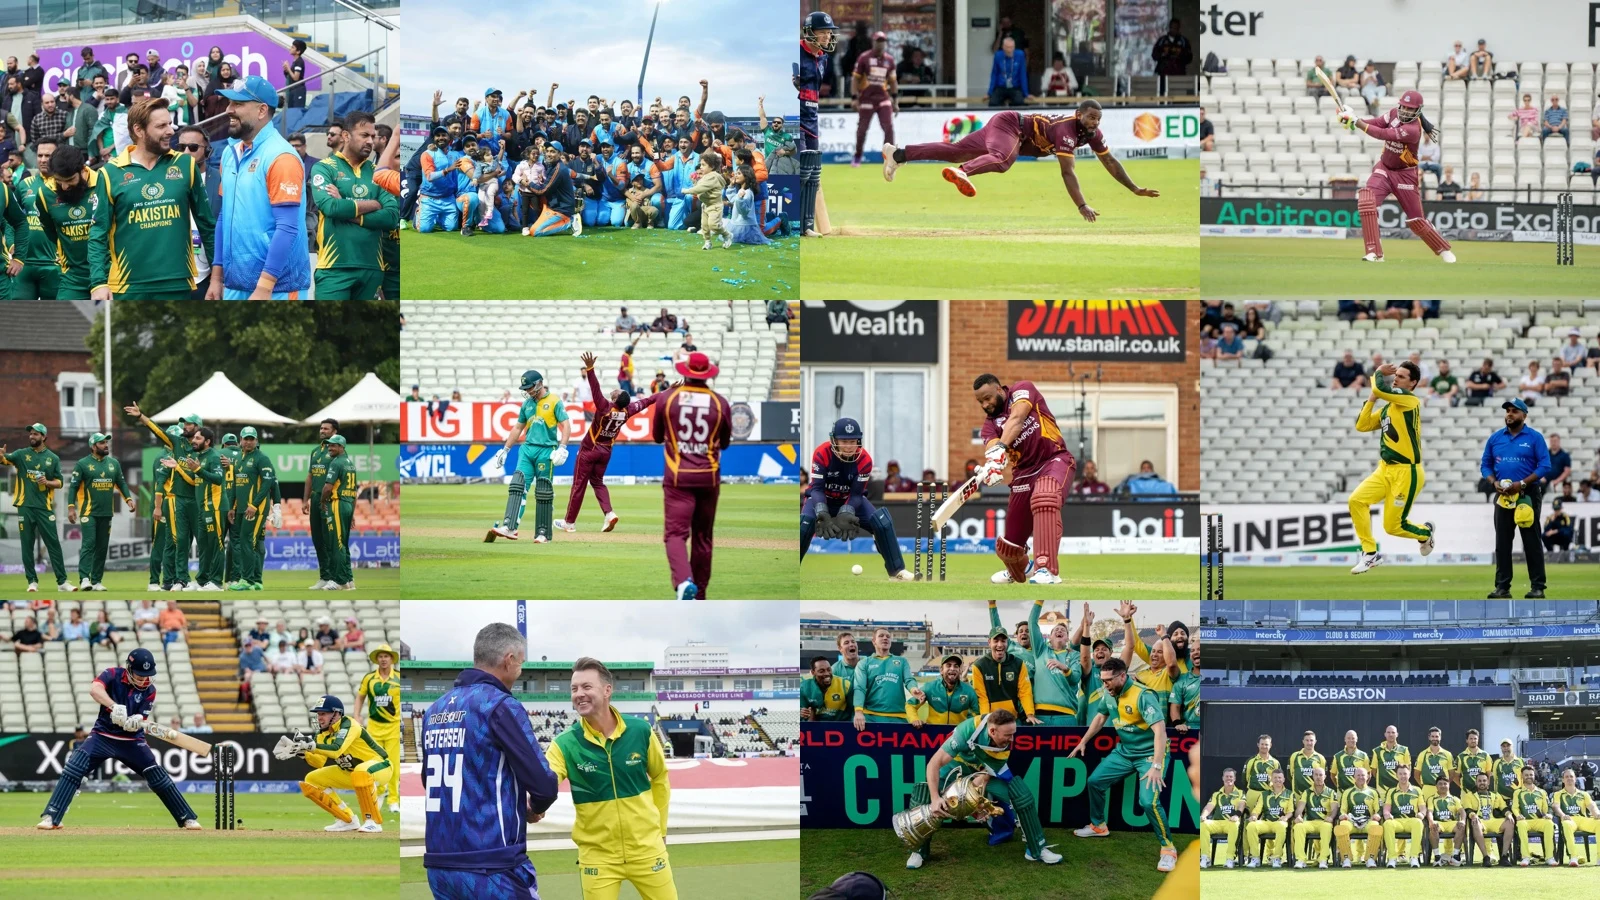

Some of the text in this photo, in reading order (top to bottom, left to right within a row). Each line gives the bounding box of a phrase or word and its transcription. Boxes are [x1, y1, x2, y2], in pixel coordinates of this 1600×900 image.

[1166, 116, 1199, 138] ED
[1126, 147, 1168, 158] LINEBET
[128, 205, 180, 223] PAKISTAN
[140, 220, 172, 229] CHAMPIONS
[828, 311, 925, 335] Wealth
[1016, 337, 1180, 354] www.stanair.co.uk
[420, 405, 460, 438] IG
[678, 407, 709, 442] 55
[677, 442, 709, 454] POLLARD
[415, 454, 456, 477] WCL
[518, 604, 526, 624] drax
[1255, 630, 1287, 641] intercity
[1325, 631, 1342, 639] CLOUD
[1350, 631, 1376, 639] SECURITY
[1412, 629, 1444, 640] intercity
[1482, 628, 1533, 637] COMMUNICATIONS
[1299, 688, 1386, 700] EDGBASTON
[703, 702, 709, 710] 4
[425, 728, 466, 750] PIETERSEN
[426, 754, 464, 812] 24
